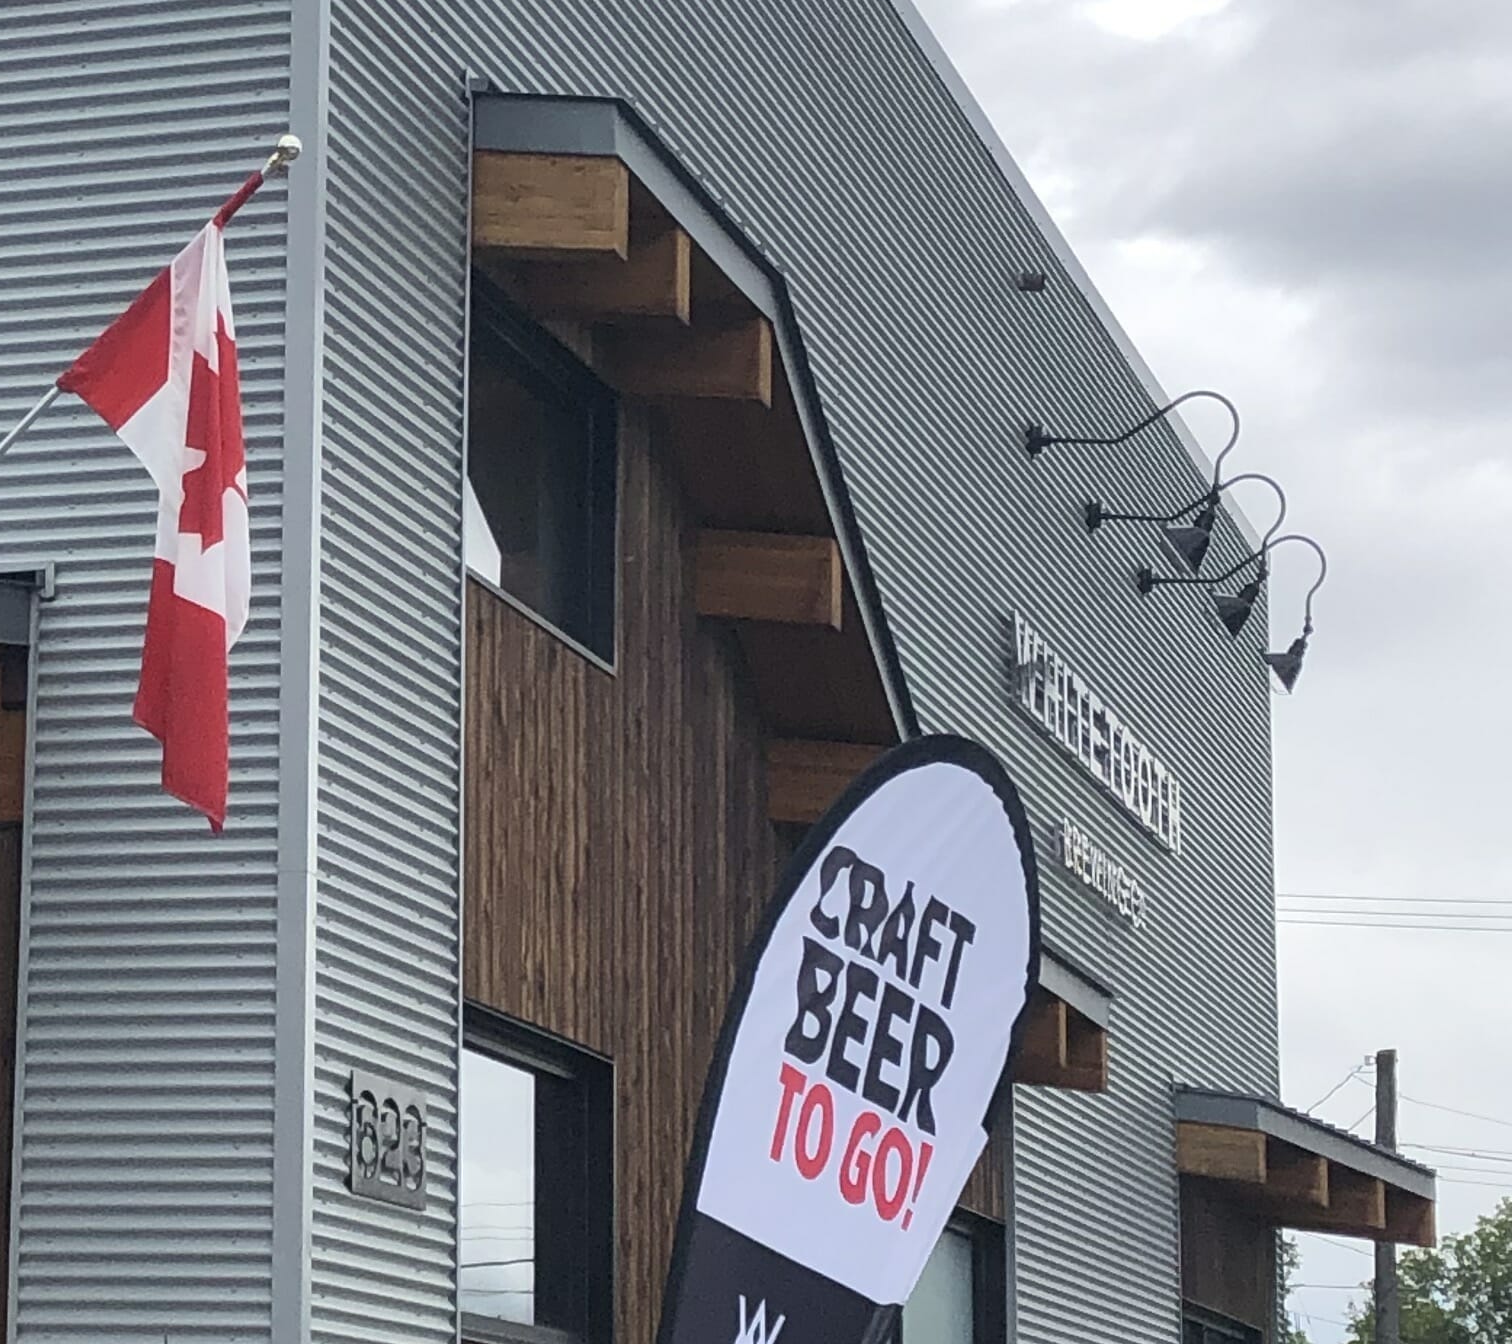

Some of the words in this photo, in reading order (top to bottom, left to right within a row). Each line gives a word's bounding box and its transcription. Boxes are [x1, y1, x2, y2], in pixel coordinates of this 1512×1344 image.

[1014, 608, 1181, 855] WHITETOOTH
[809, 845, 976, 1009] CRAFT
[784, 936, 955, 1135] BEER
[769, 1061, 835, 1182] TO
[839, 1109, 935, 1232] GO!
